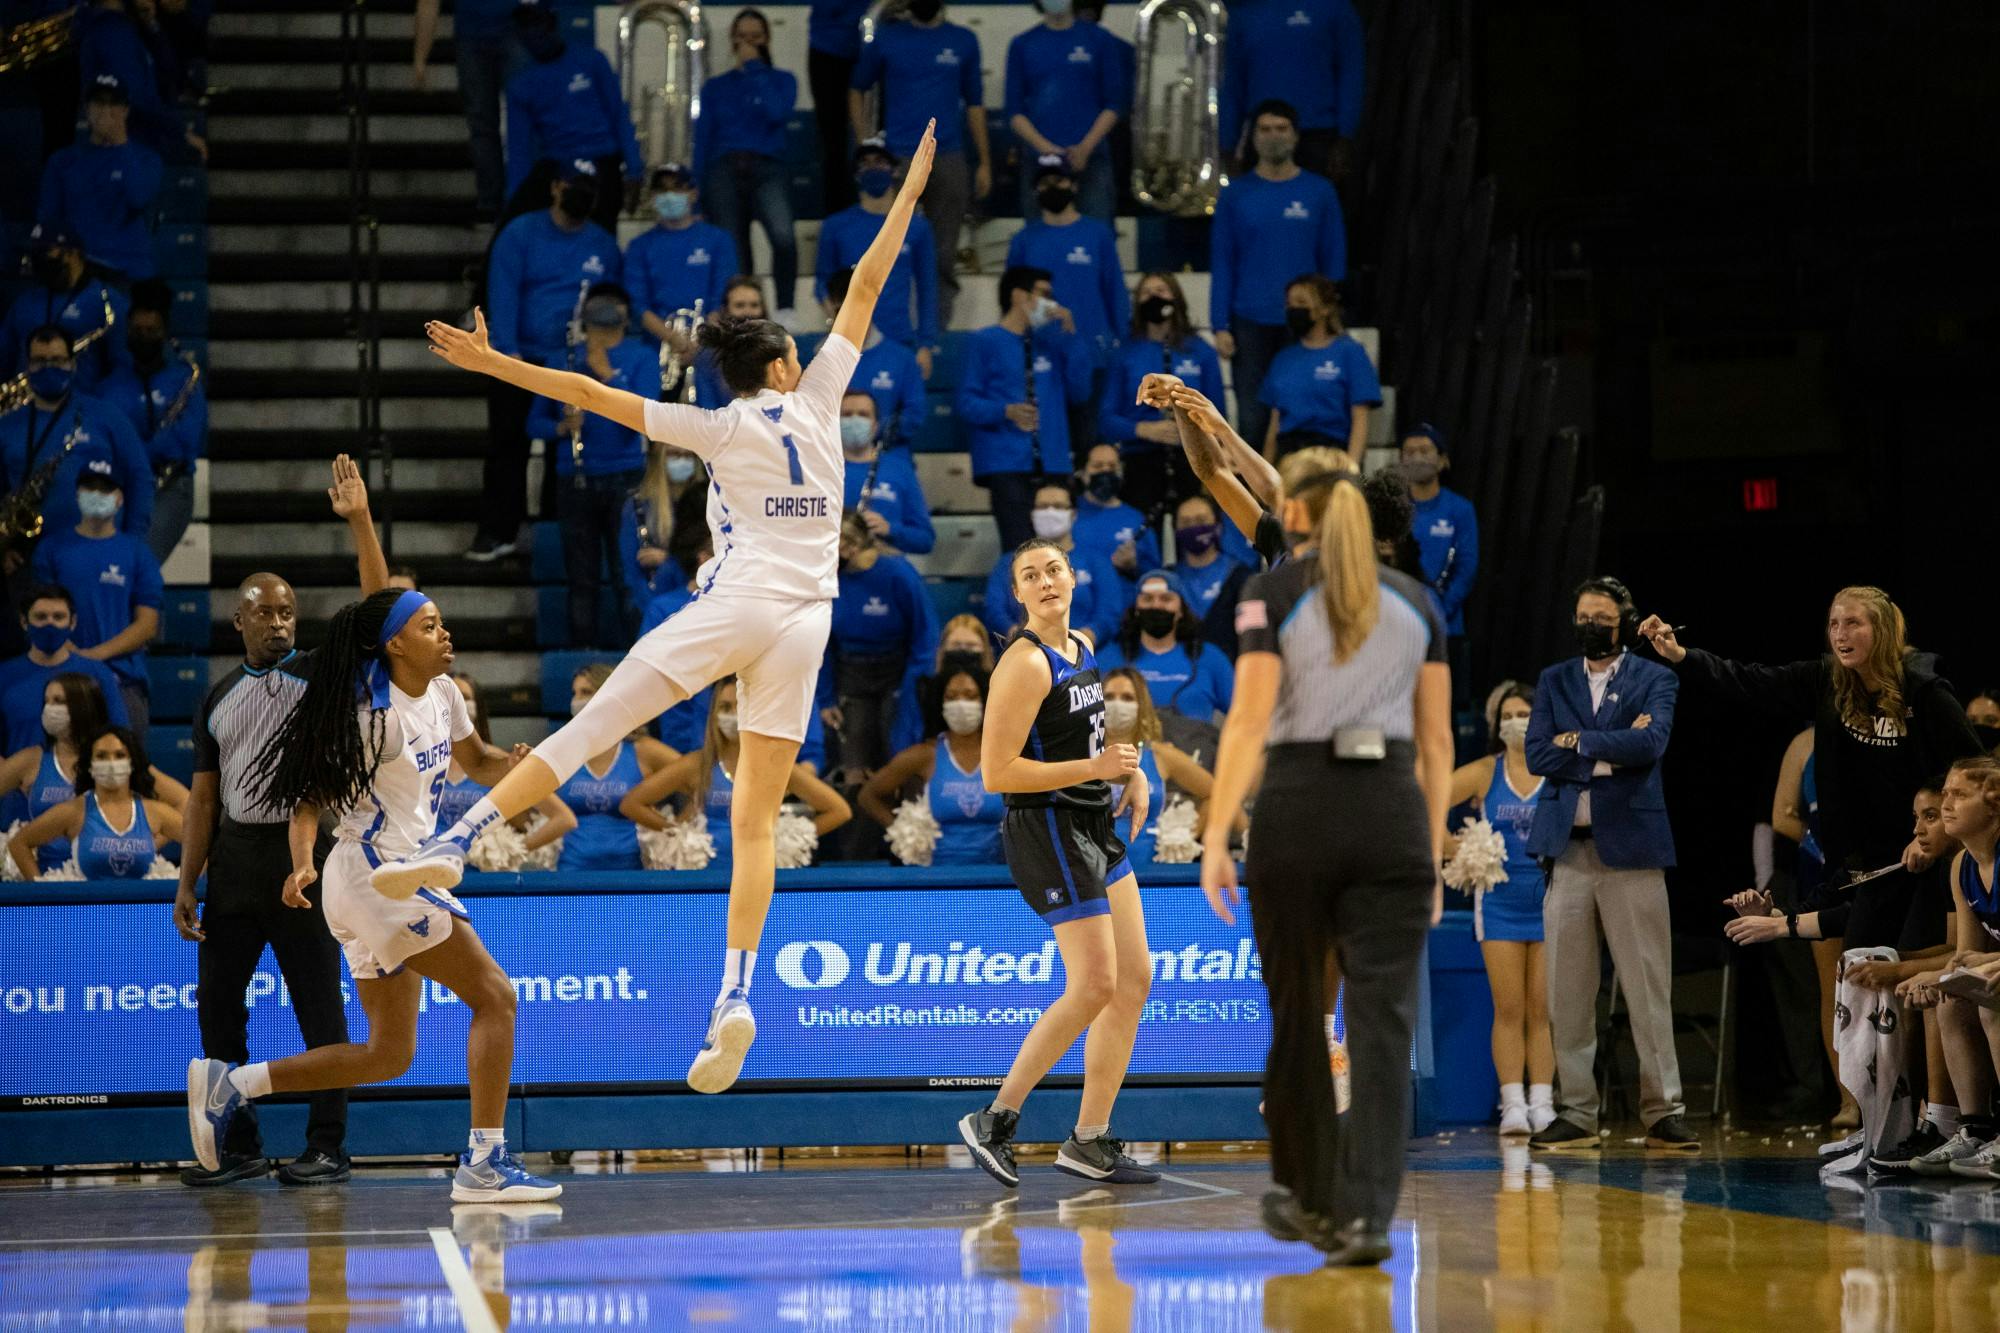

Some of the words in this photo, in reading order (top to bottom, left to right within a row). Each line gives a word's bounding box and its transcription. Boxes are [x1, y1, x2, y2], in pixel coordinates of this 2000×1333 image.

[781, 433, 804, 486] 1
[764, 496, 828, 518] CHRISTIE
[429, 768, 447, 816] 5
[863, 940, 1058, 985] United
[1149, 937, 1264, 982] ntals
[0, 984, 65, 1014] ou
[797, 1003, 1042, 1028] UnitedRentals.com
[22, 1095, 108, 1106] DAKTRONICS
